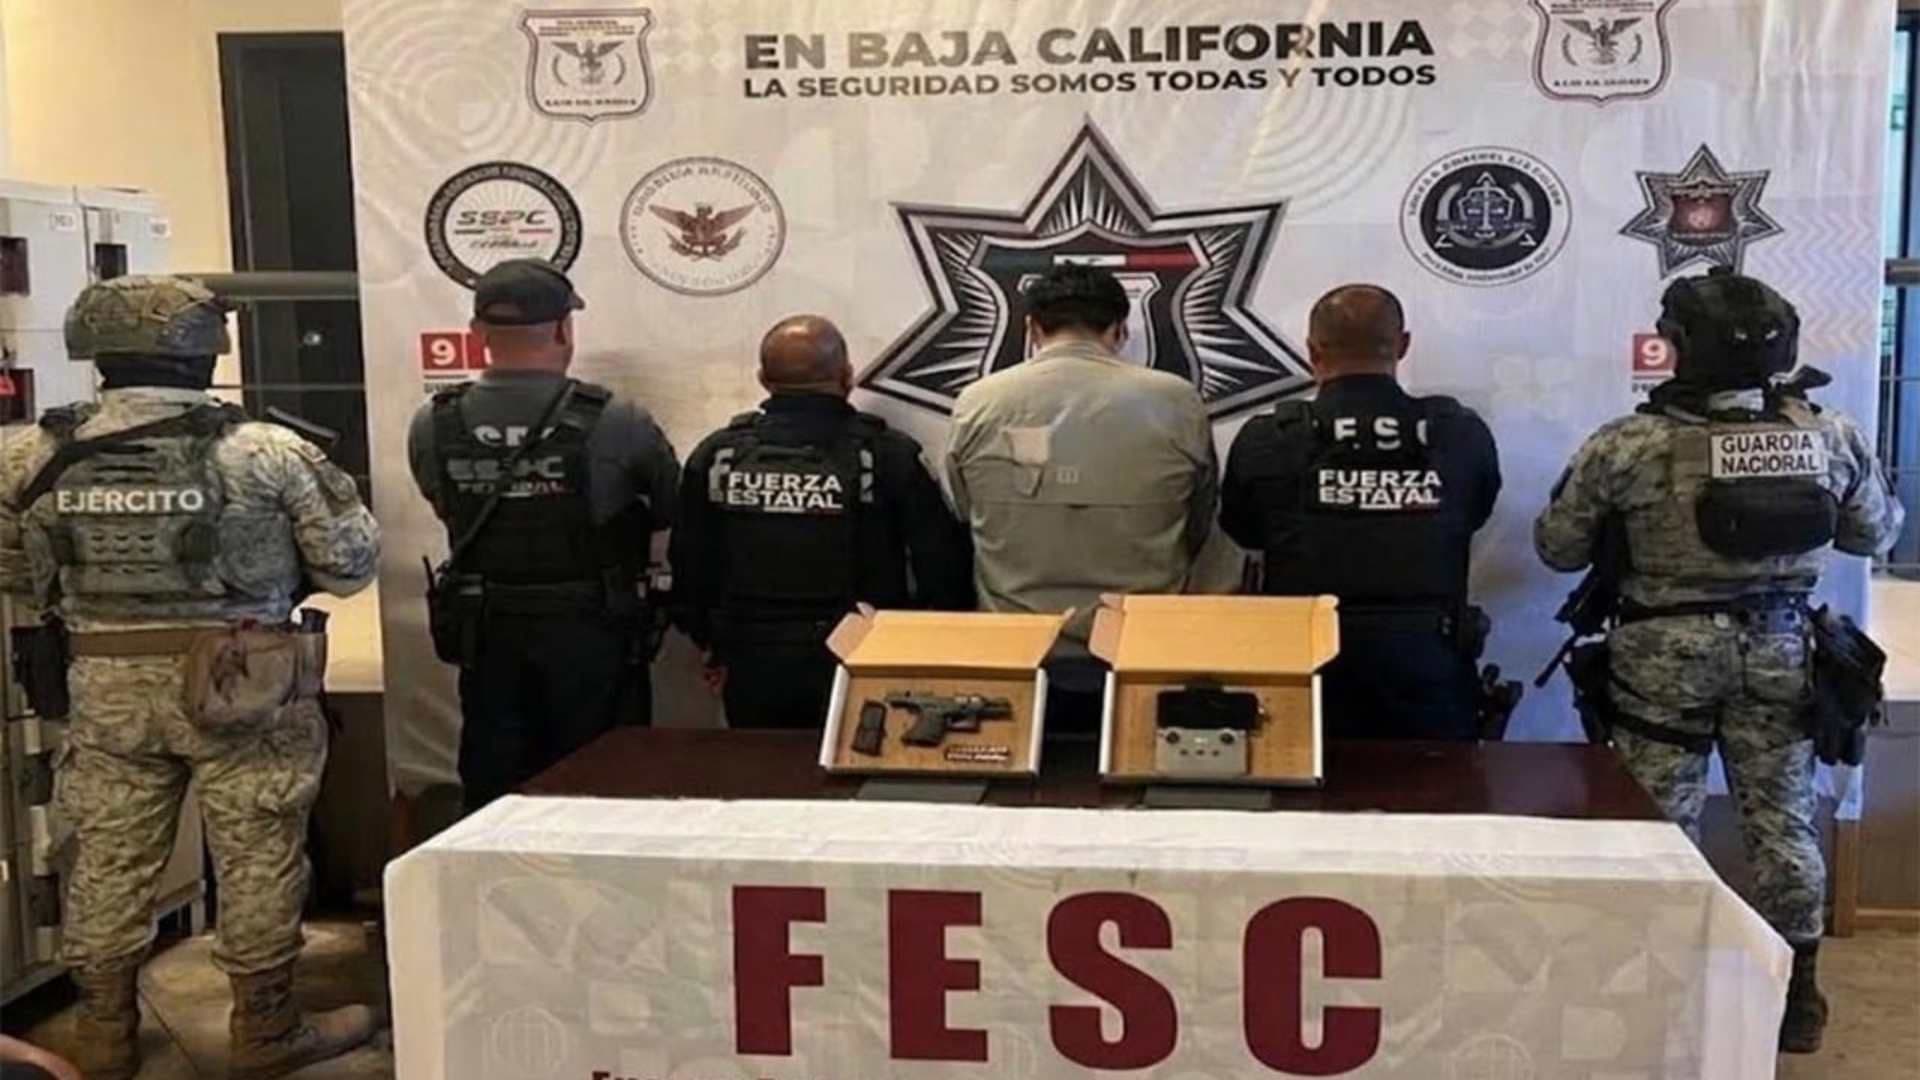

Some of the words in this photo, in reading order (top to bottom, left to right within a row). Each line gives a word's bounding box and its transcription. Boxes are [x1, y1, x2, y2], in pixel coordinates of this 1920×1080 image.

[744, 34, 826, 70] EN
[848, 30, 1017, 69] BAJA
[1037, 20, 1435, 65] CALIFORNIA
[744, 78, 787, 99] LA
[797, 75, 999, 97] SEGURIDAD
[1011, 71, 1137, 95] SOMOS
[1147, 68, 1268, 91] TODAS
[1278, 67, 1300, 88] Y
[1312, 64, 1436, 87] TODOS
[728, 472, 843, 493] FUERZA
[1318, 469, 1442, 487] FUERZA
[57, 485, 204, 512] EJÉRCITO
[726, 489, 844, 509] ESTATAL
[1318, 487, 1442, 505] ESTATAL
[732, 884, 1385, 1077] FESC
